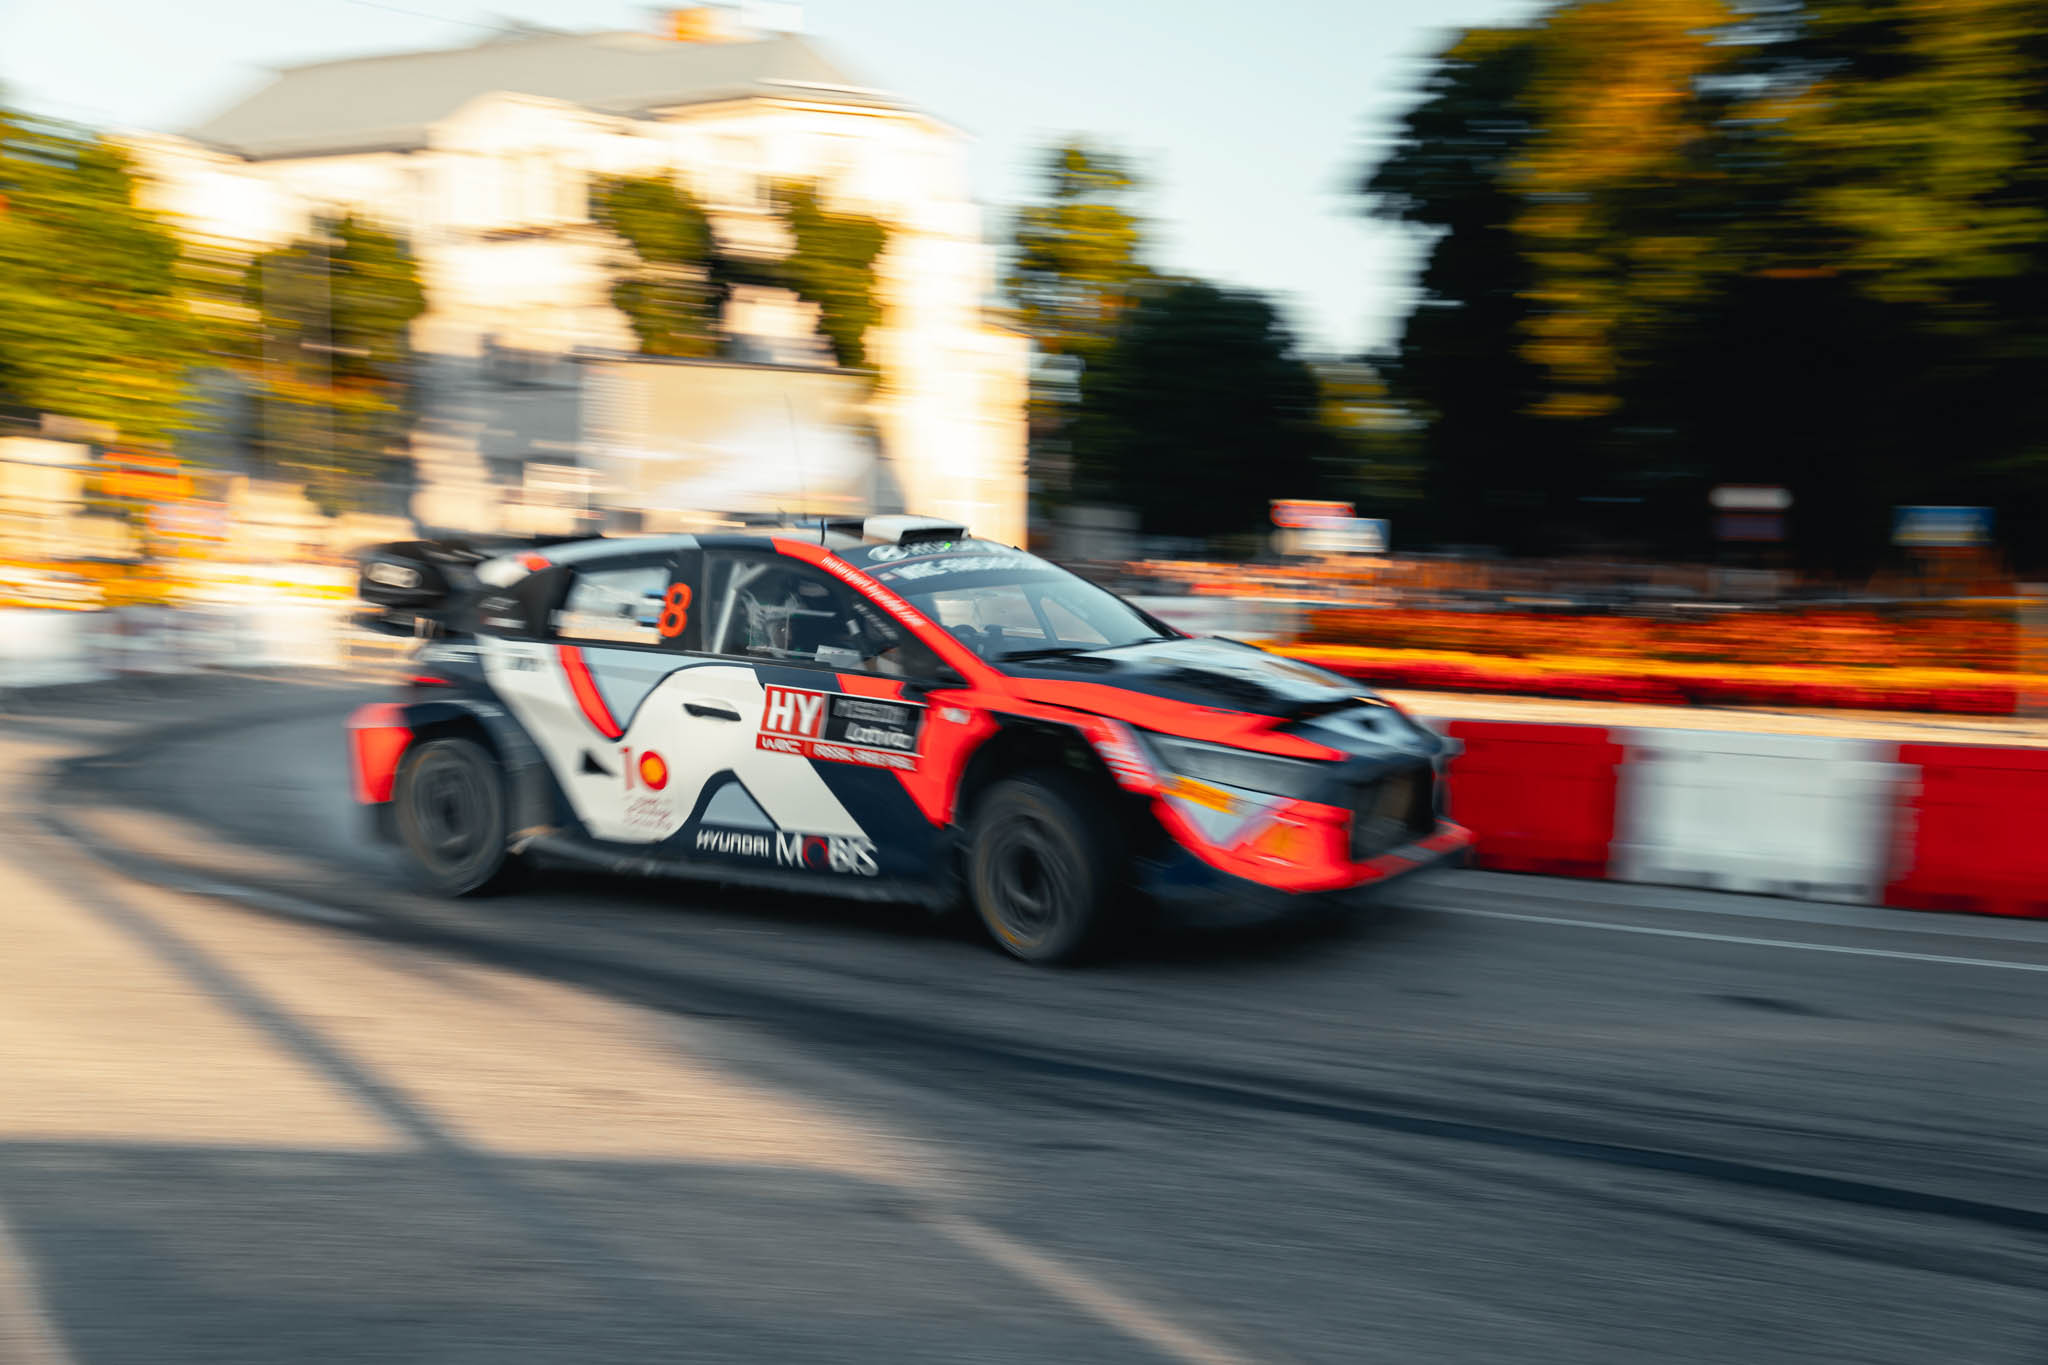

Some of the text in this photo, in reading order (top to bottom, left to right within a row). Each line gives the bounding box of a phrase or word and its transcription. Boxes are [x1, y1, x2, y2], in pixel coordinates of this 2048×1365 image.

[656, 581, 693, 638] 8
[767, 690, 824, 735] HY
[696, 829, 770, 858] HYUNDAI
